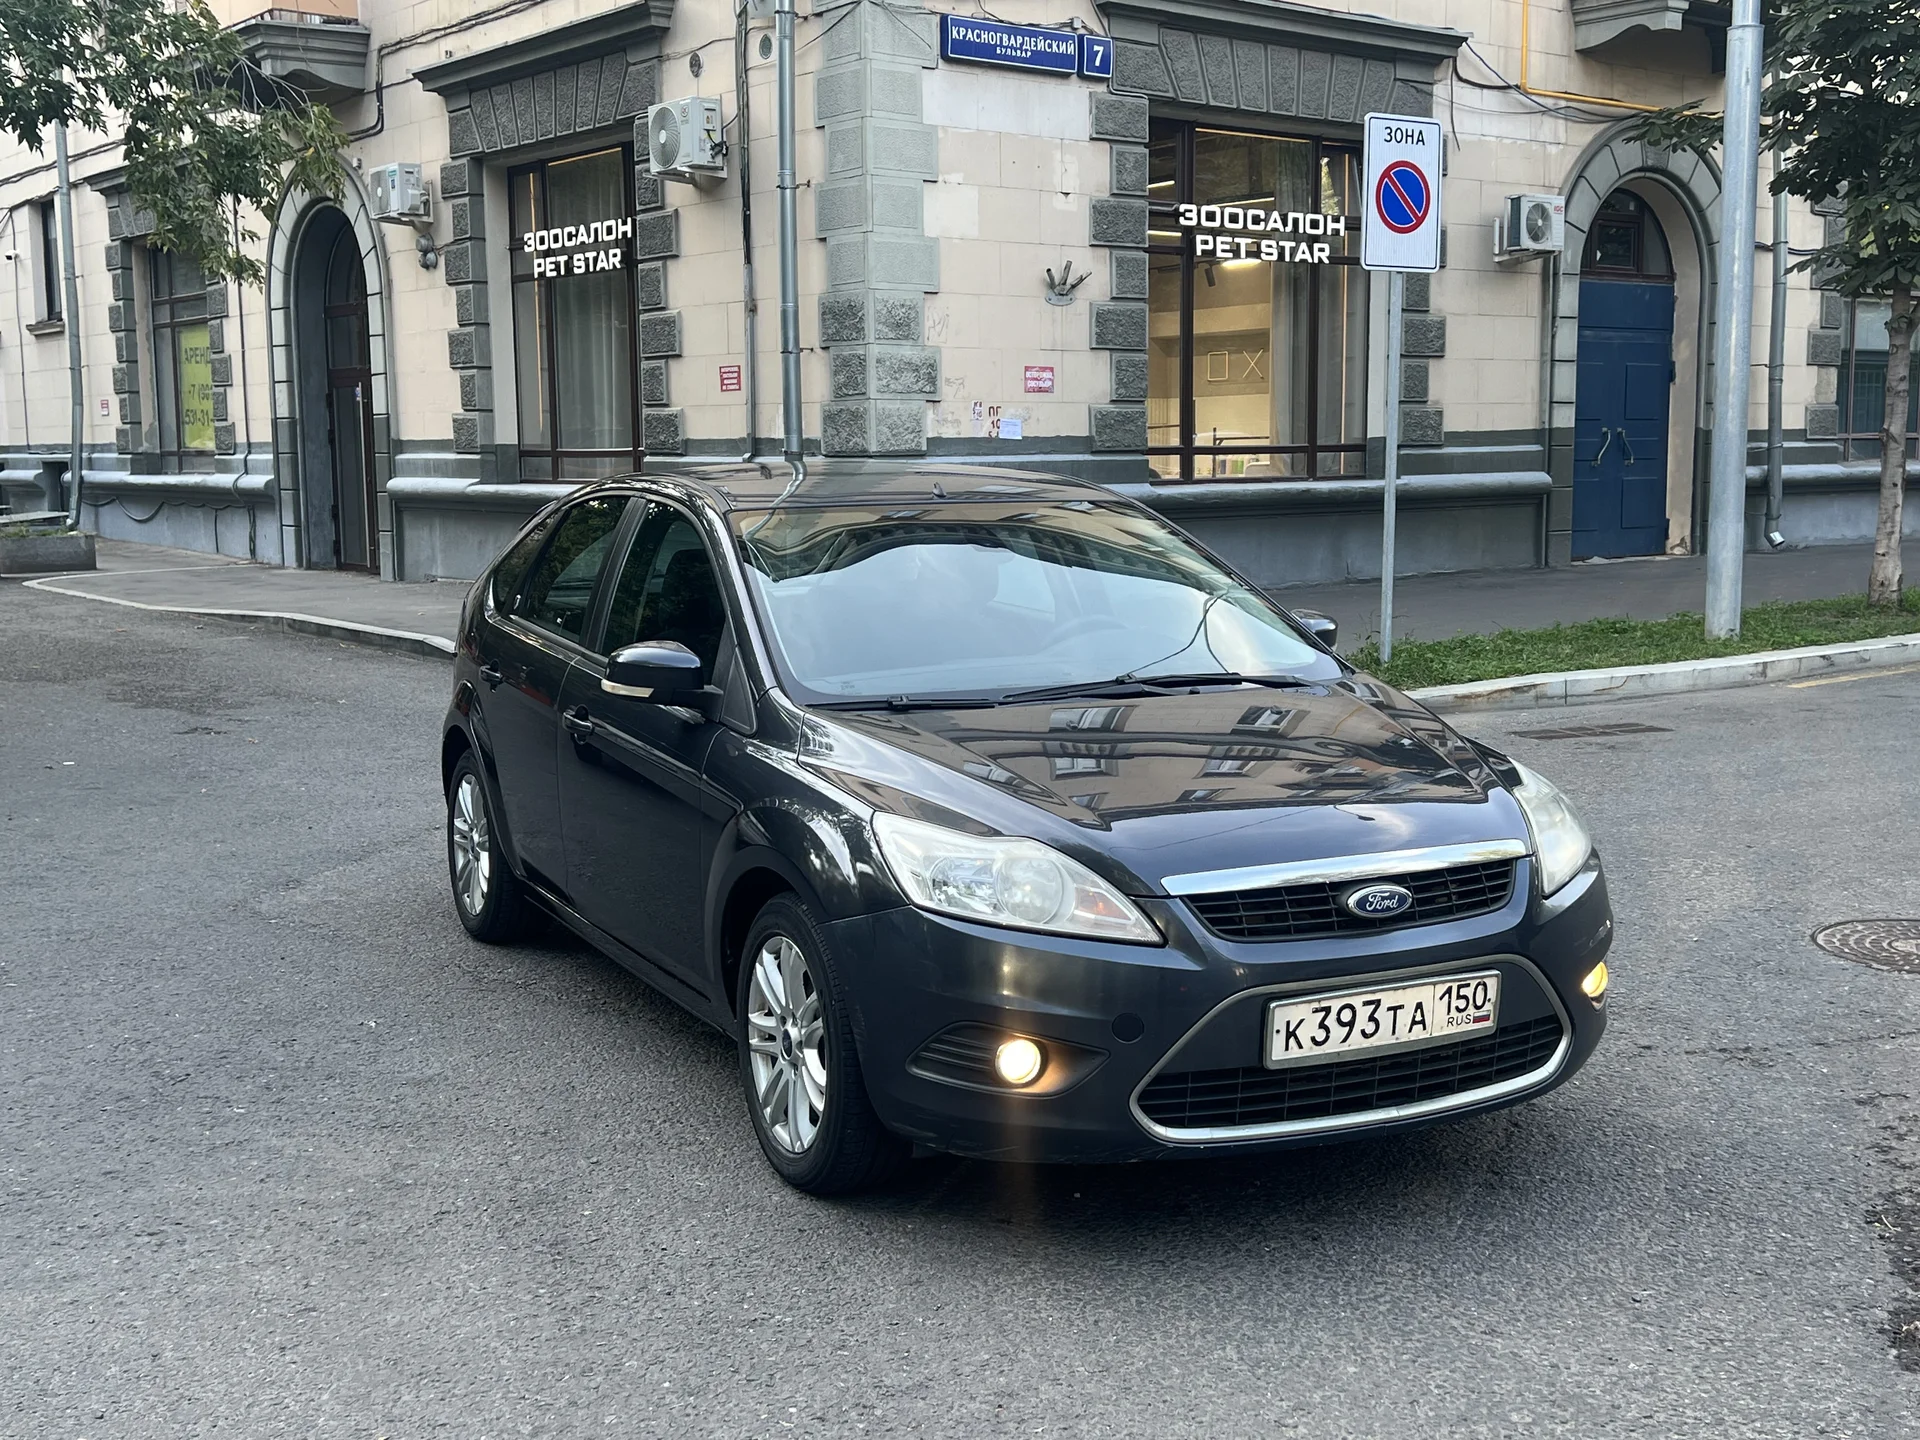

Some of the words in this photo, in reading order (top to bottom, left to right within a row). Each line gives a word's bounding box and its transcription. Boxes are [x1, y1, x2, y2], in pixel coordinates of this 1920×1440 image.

[951, 25, 1075, 56] КРАСНОГВАРДЕЙСКИЙ
[995, 48, 1032, 58] БУЛЬВАР
[1093, 45, 1104, 67] 7
[1383, 126, 1426, 146] ЗОНА
[1178, 203, 1346, 237] ЗООСАЛОН
[523, 217, 632, 253] ЗООСАЛОН
[1195, 234, 1252, 259] PET
[1260, 239, 1331, 264] STAR
[533, 254, 568, 279] PET
[572, 248, 622, 274] STAR
[184, 346, 211, 366] АРЕНД
[1365, 891, 1399, 911] Ford
[1283, 998, 1428, 1052] К393ТА
[1438, 980, 1488, 1016] 150
[1446, 1013, 1472, 1028] RUS
